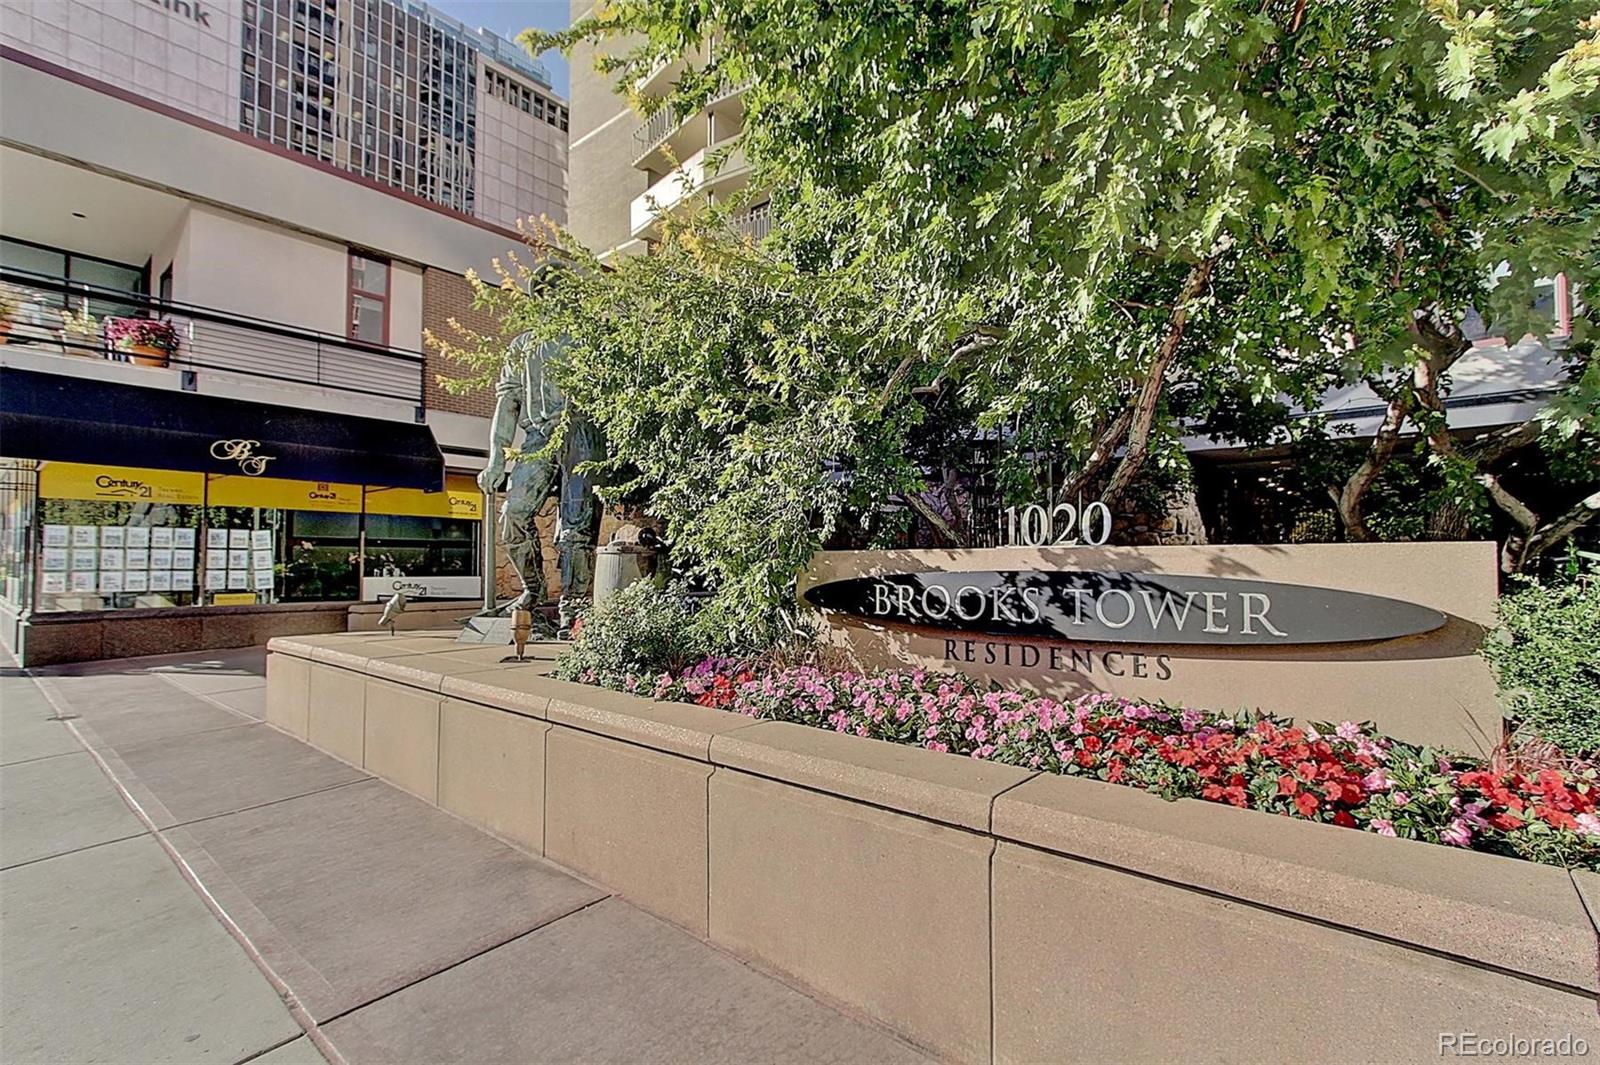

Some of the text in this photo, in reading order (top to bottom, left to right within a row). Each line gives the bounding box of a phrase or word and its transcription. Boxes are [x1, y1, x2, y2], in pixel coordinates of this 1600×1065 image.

[95, 475, 144, 490] Century
[140, 486, 152, 498] 21
[1004, 501, 1112, 546] 1020
[392, 580, 421, 592] Century
[418, 587, 427, 596] 21
[873, 584, 1288, 637] BROOKS TOWER
[944, 639, 1172, 681] RESIDENCES
